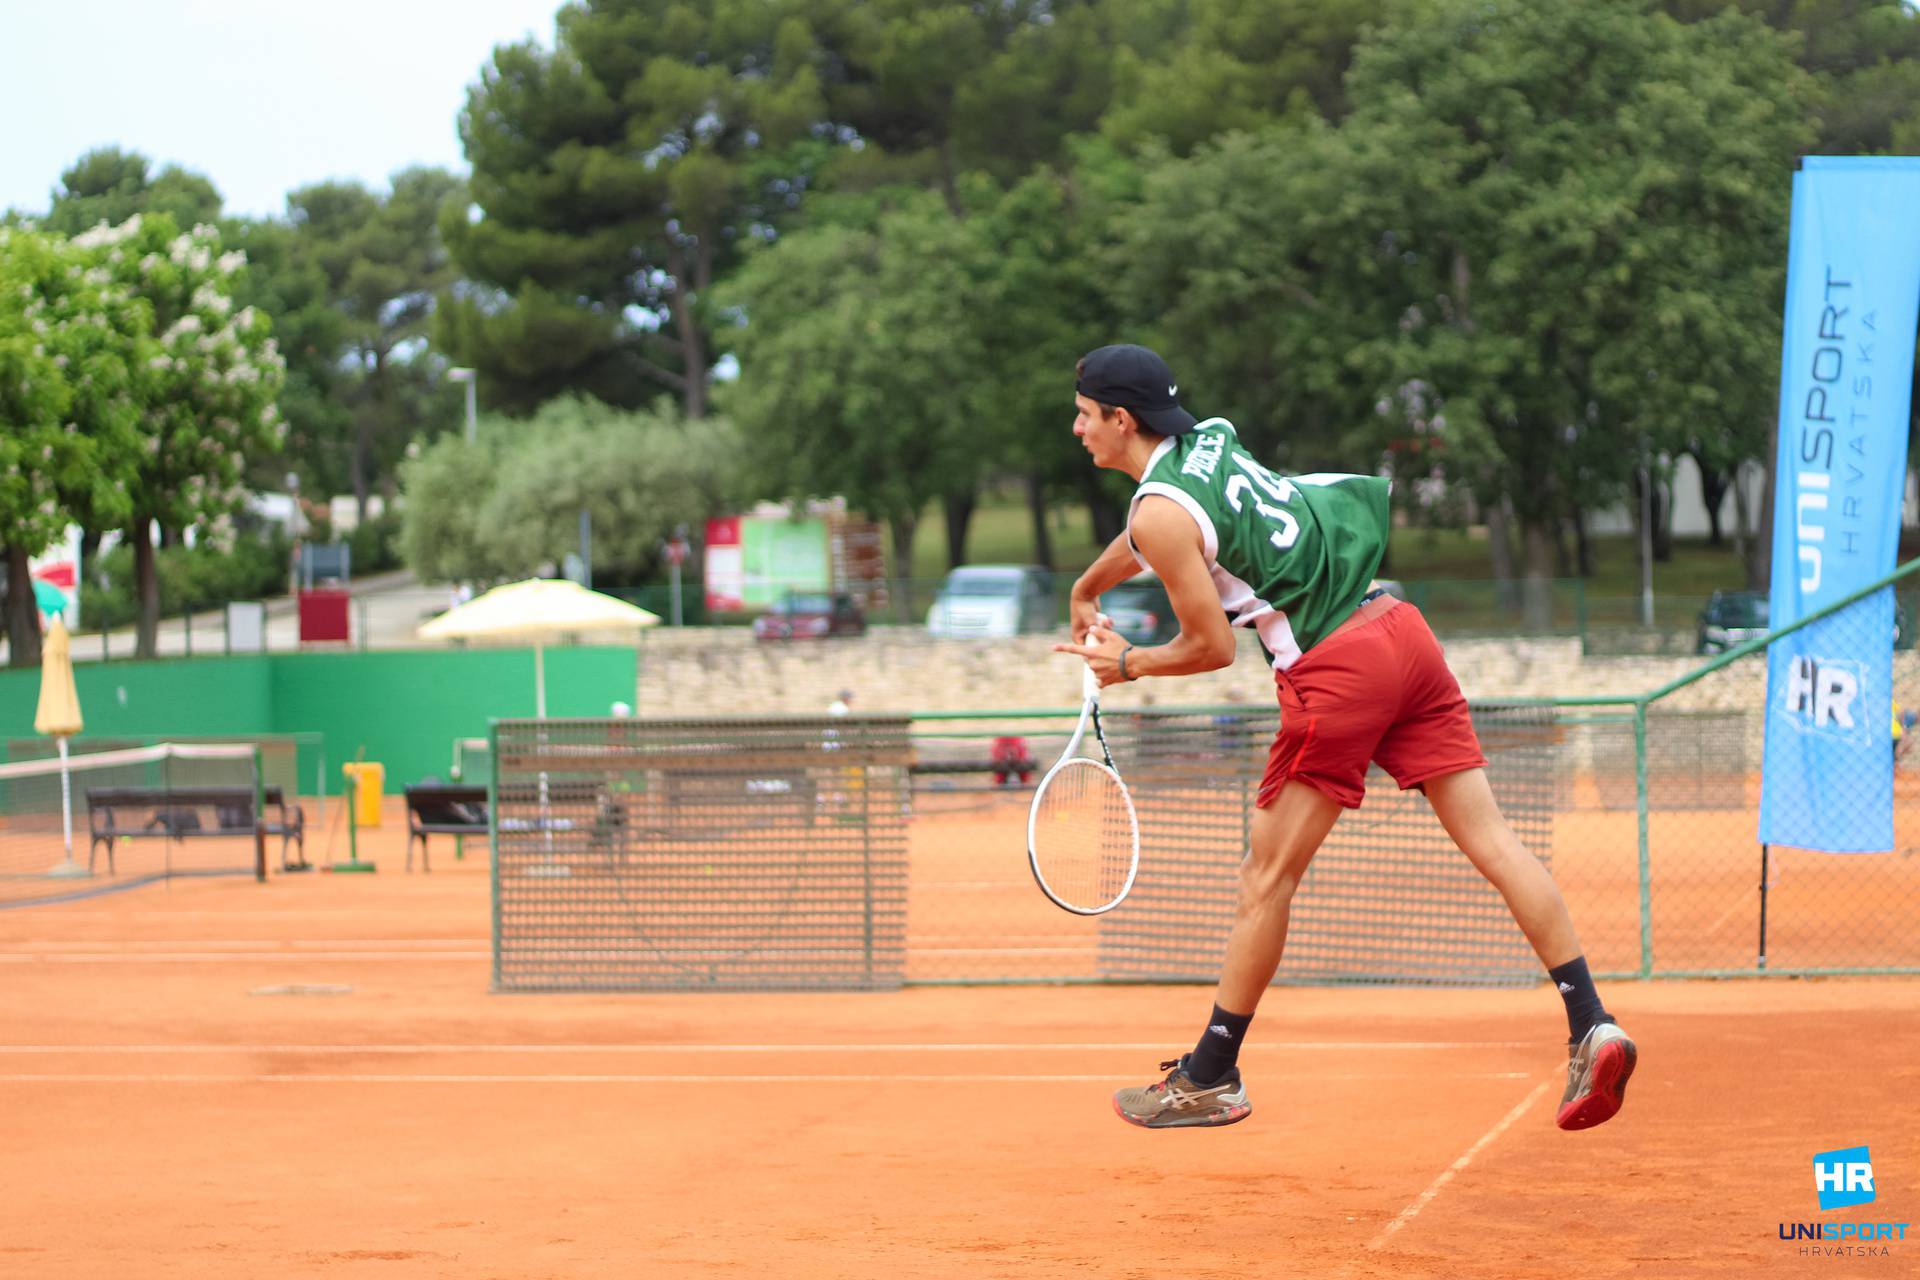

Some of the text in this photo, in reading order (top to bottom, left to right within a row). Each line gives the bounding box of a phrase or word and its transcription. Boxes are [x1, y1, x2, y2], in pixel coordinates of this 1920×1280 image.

[1840, 308, 1878, 555] HRVATSKA
[1225, 451, 1302, 548] 34
[1785, 654, 1858, 728] HR
